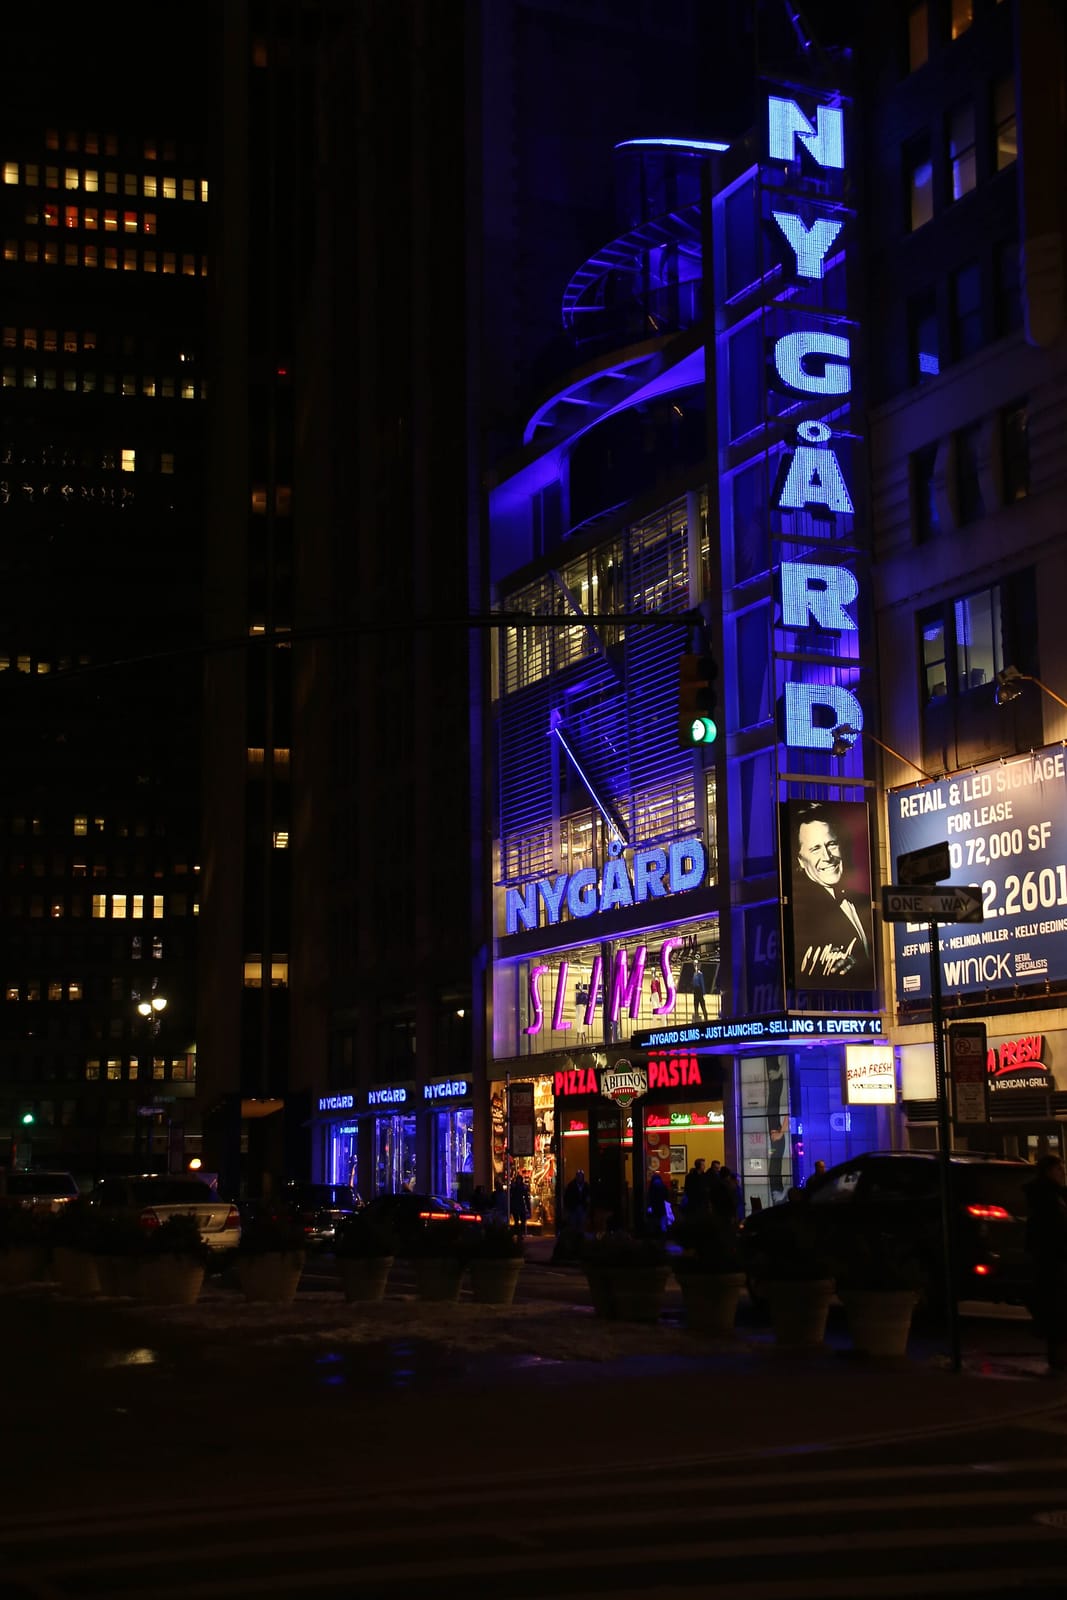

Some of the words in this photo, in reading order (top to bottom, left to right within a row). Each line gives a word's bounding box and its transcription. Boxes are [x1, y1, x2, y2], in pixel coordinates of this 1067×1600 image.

[901, 788, 946, 818] RETAIL
[949, 784, 960, 806] &
[963, 775, 991, 802] LED
[996, 754, 1065, 792] SIGNAGE
[947, 812, 971, 834] FOR
[974, 801, 1013, 827] LEASE
[966, 829, 1022, 866] 72,000
[1027, 822, 1051, 851] SF
[890, 897, 923, 911] ONE
[940, 897, 970, 911] WAY
[902, 944, 918, 957] JEFF
[950, 934, 981, 949] MELINDA
[982, 928, 1008, 945] MILLER
[1015, 923, 1038, 939] KELLY
[524, 936, 683, 1034] SLIMS
[680, 1028, 700, 1042] SLIMS
[705, 1027, 722, 1039] JUST
[723, 1022, 763, 1037] LAUNCHED
[827, 1020, 866, 1033] EVERY
[869, 1062, 892, 1074] FRESH
[1000, 1034, 1042, 1069] FRESH
[555, 1068, 599, 1097] PIZZA
[648, 1057, 703, 1089] PASTA
